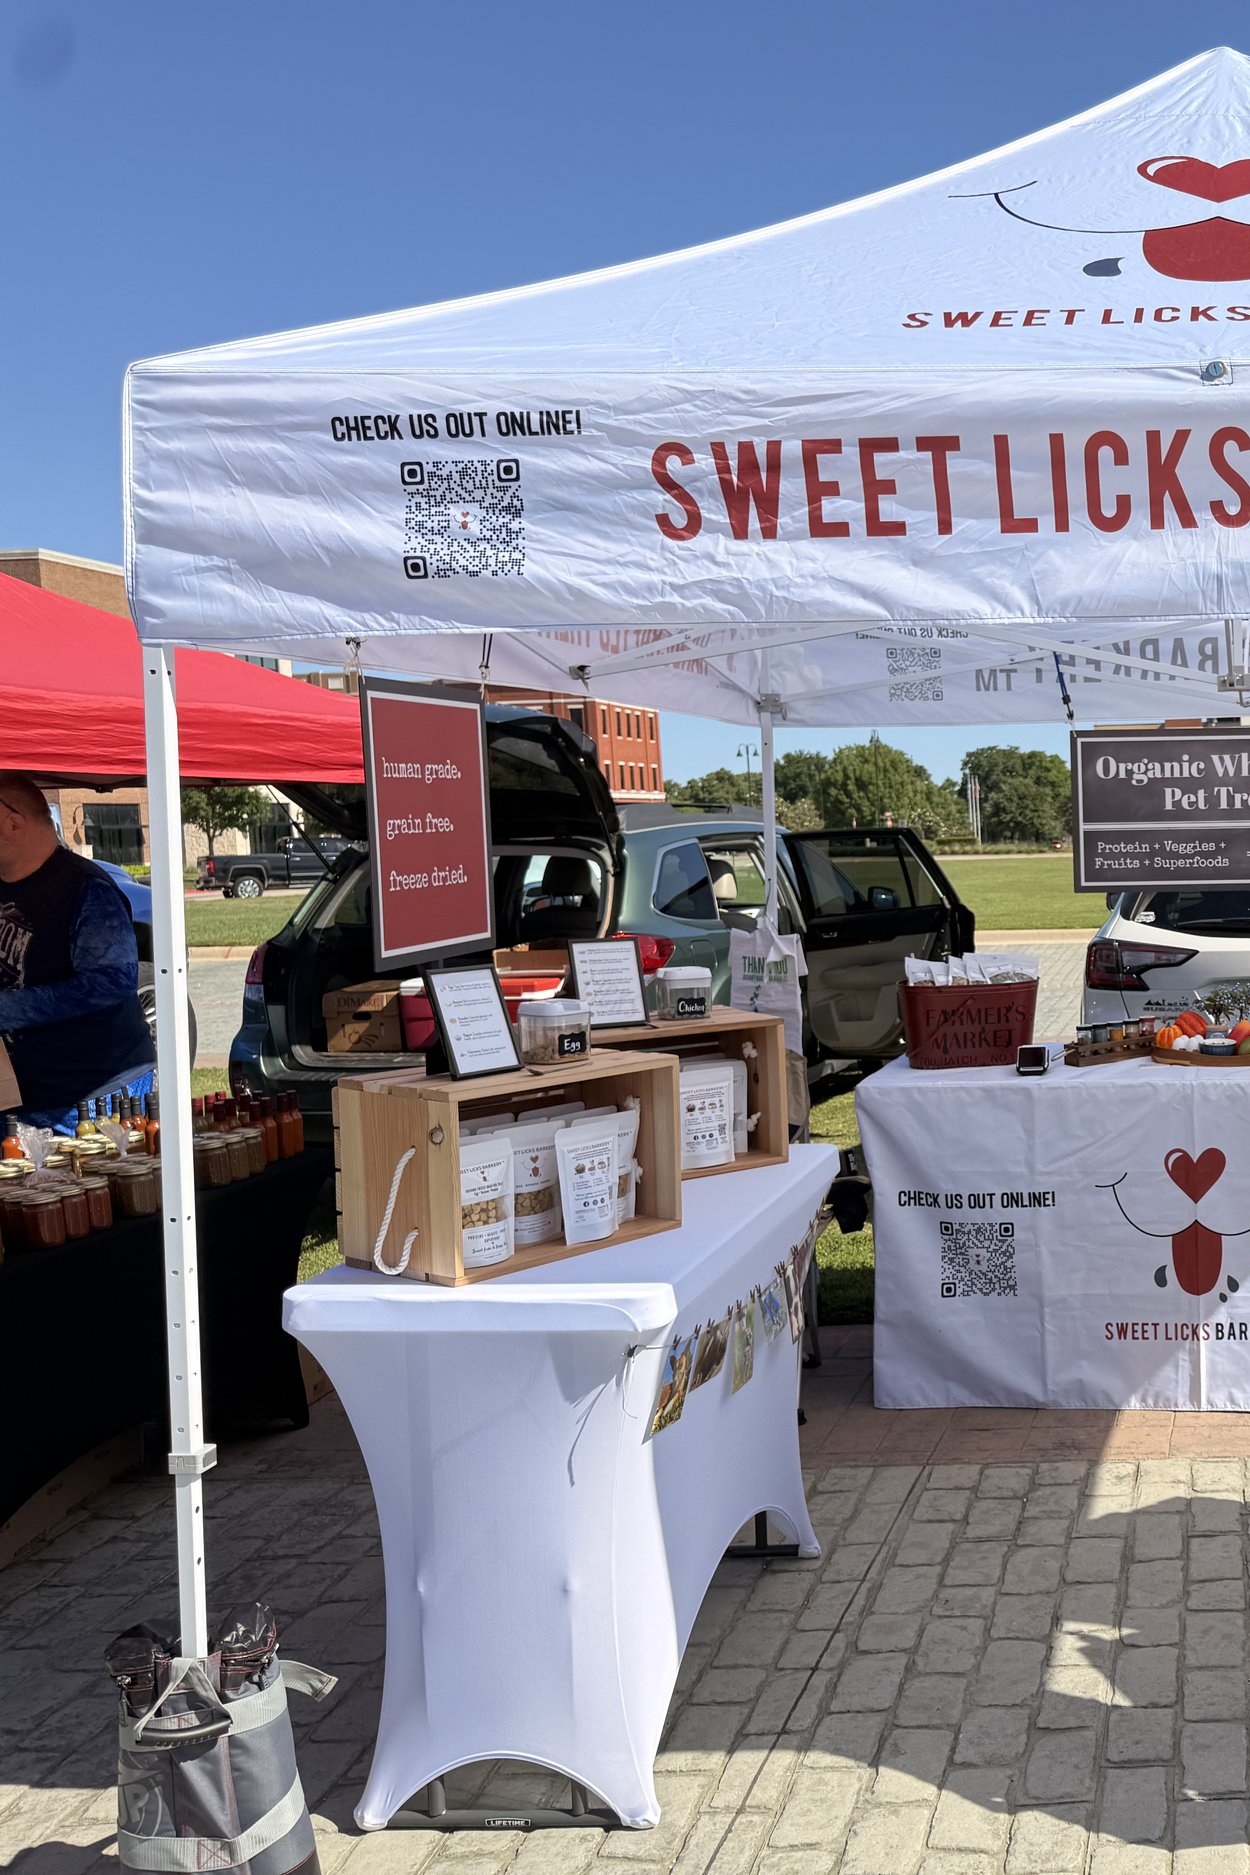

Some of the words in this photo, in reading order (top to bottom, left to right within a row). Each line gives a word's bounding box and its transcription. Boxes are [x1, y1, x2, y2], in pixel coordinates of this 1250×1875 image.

[902, 308, 1086, 329] SWEET
[331, 414, 403, 442] CHECK
[408, 413, 439, 440] US
[445, 412, 487, 439] OUT
[496, 409, 583, 437] ONLINE!
[651, 435, 961, 542] SWEET
[382, 757, 422, 779] human
[425, 759, 462, 783] grade.
[1095, 753, 1206, 786] Organic
[1163, 787, 1209, 811] Pet
[386, 813, 423, 841] grain
[425, 812, 454, 833] free.
[1097, 840, 1150, 854] Protein
[1163, 840, 1216, 855] Veggies
[1095, 856, 1141, 869] Fruits
[1153, 855, 1230, 870] Superfoods
[389, 869, 429, 892] freeze
[431, 864, 468, 886] dried.
[678, 1000, 705, 1013] Chicken
[925, 1002, 1026, 1027] FARMER'S
[563, 1038, 581, 1051] Egg
[932, 1028, 1016, 1050] MARKET
[898, 1190, 941, 1208] CHECK
[944, 1192, 963, 1209] US
[967, 1192, 996, 1209] OUT
[1000, 1190, 1057, 1208] ONLINE!
[1104, 1322, 1159, 1341] SWEET
[1164, 1322, 1210, 1341] LICKS
